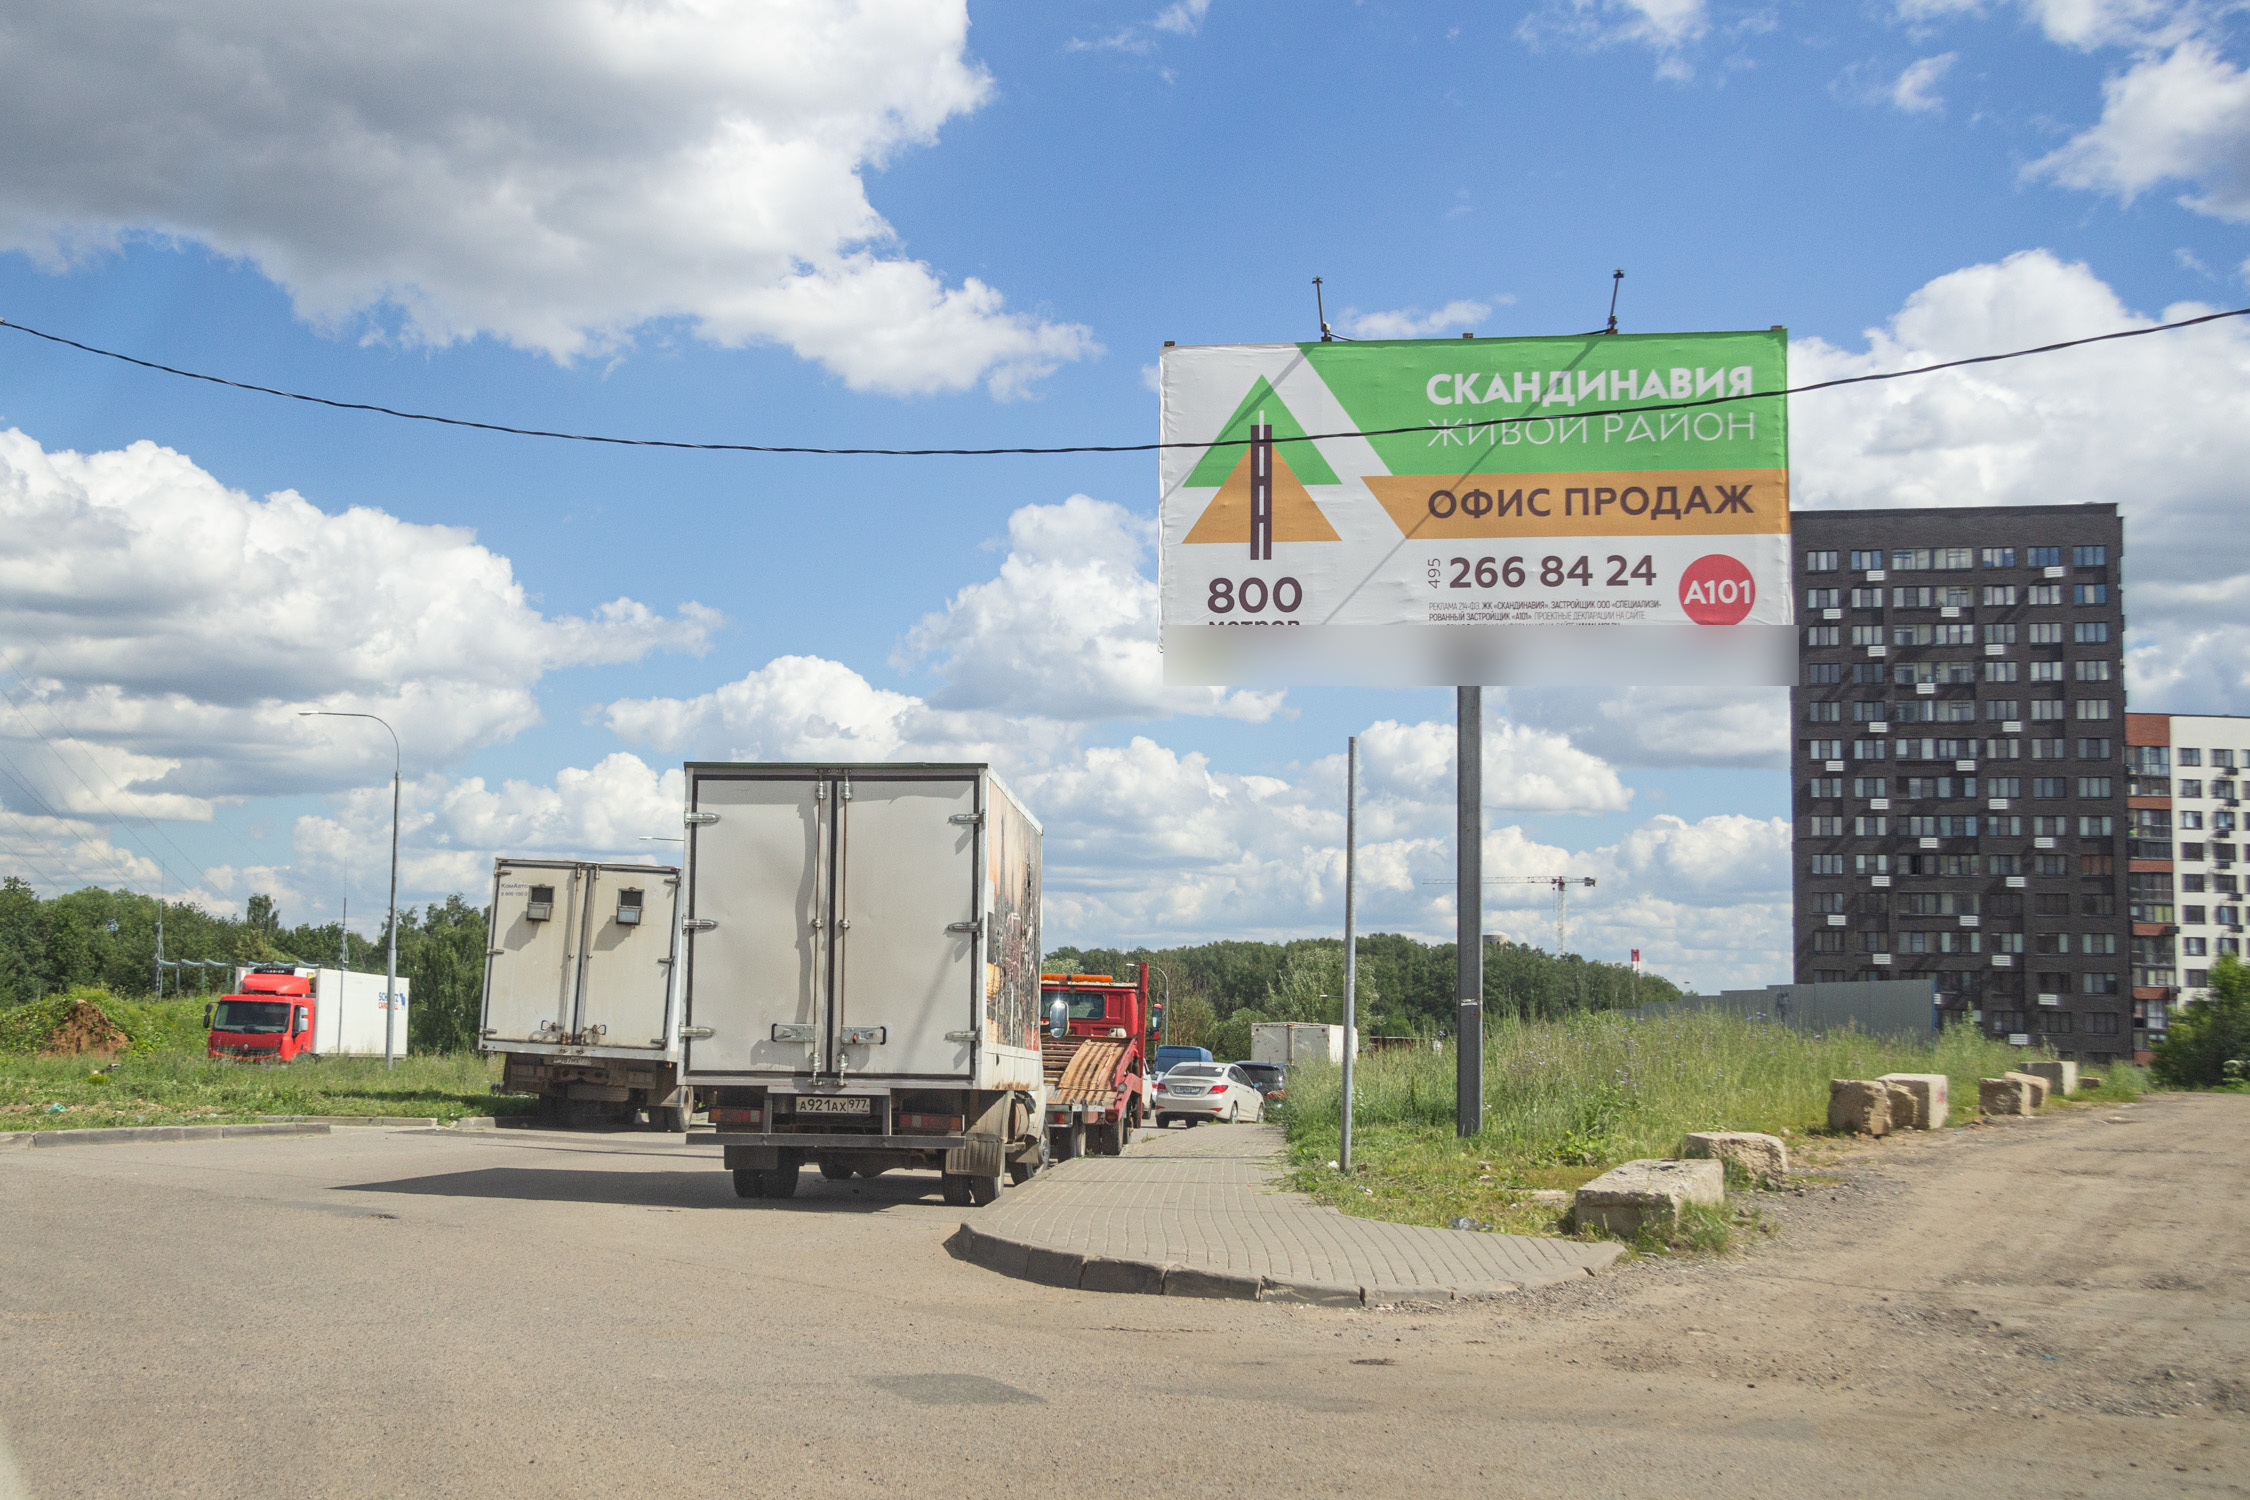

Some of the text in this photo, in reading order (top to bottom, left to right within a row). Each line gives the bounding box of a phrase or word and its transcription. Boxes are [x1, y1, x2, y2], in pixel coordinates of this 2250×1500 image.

[1426, 366, 1752, 407] СКАНДИНАВИЯ
[1428, 412, 1755, 447] ЖИВОЙ РАЙОН
[1428, 485, 1754, 520] ОФИС ПРОДАЖ
[1427, 558, 1441, 589] 495
[1449, 555, 1657, 589] 266 84 24
[1207, 577, 1303, 613] 800
[1428, 602, 1457, 611] РЕКЛАМА
[1482, 601, 1493, 609] ЖК
[1551, 599, 1595, 610] ЗАСТРОЙЩИК
[1597, 600, 1611, 609] ООО
[1428, 611, 1465, 621] РОВАННЫЙ
[1466, 611, 1511, 621] ЗАСТРОЙЩИК
[1534, 612, 1572, 620] ПРОЕКТНЫЕ
[1573, 611, 1615, 620] ДЕКЛАРАЦИИ
[1616, 611, 1625, 619] НА
[1626, 609, 1645, 619] САЙТЕ
[800, 1099, 866, 1111] А921АХ 977
